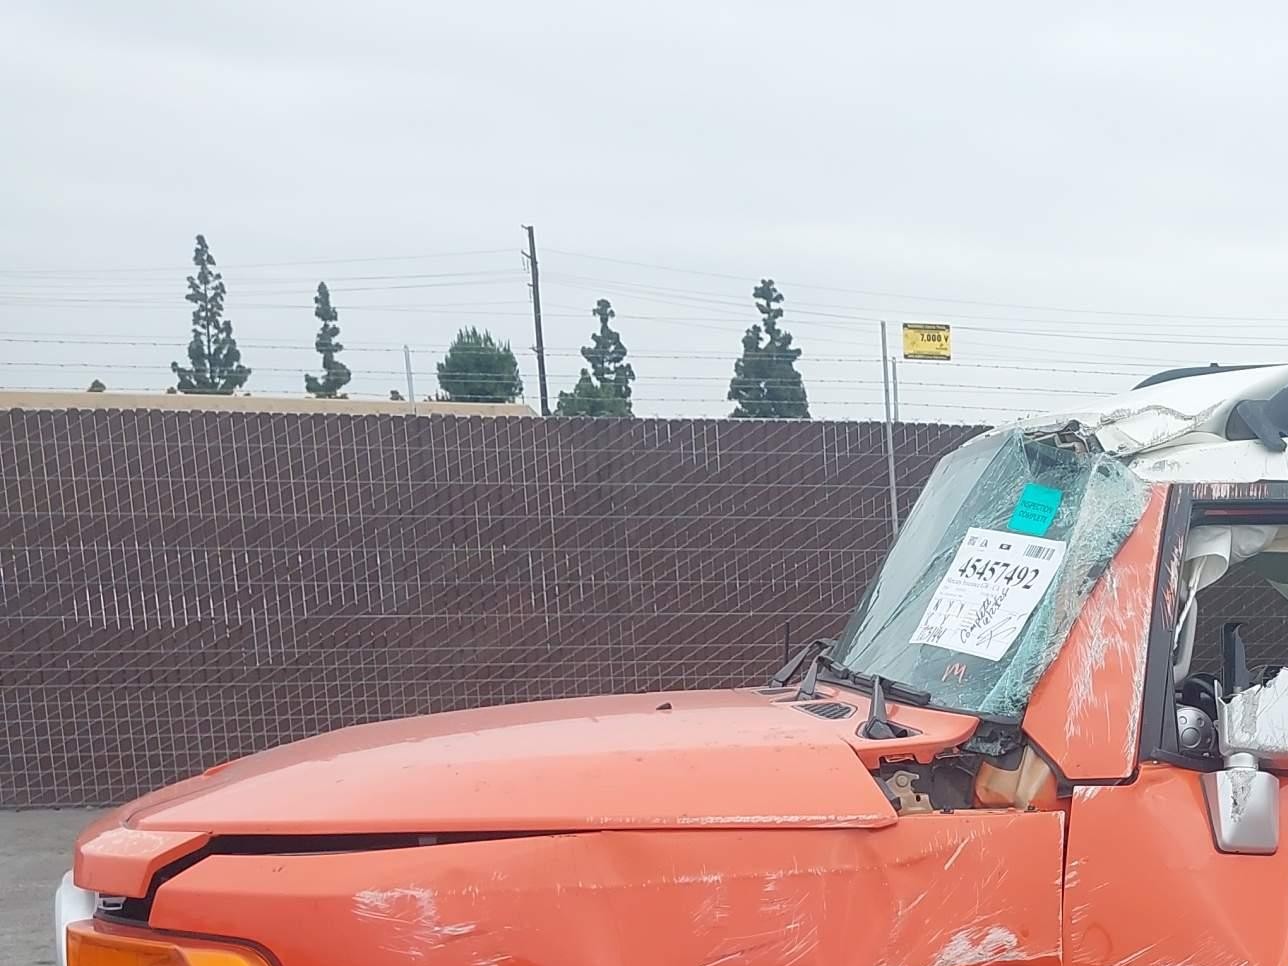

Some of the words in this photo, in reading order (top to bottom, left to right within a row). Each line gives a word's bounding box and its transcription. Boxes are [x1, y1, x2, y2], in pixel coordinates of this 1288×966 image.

[1020, 500, 1053, 513] INSPECTION
[1018, 510, 1048, 522] COMPLETE
[958, 556, 1040, 590] 45457492
